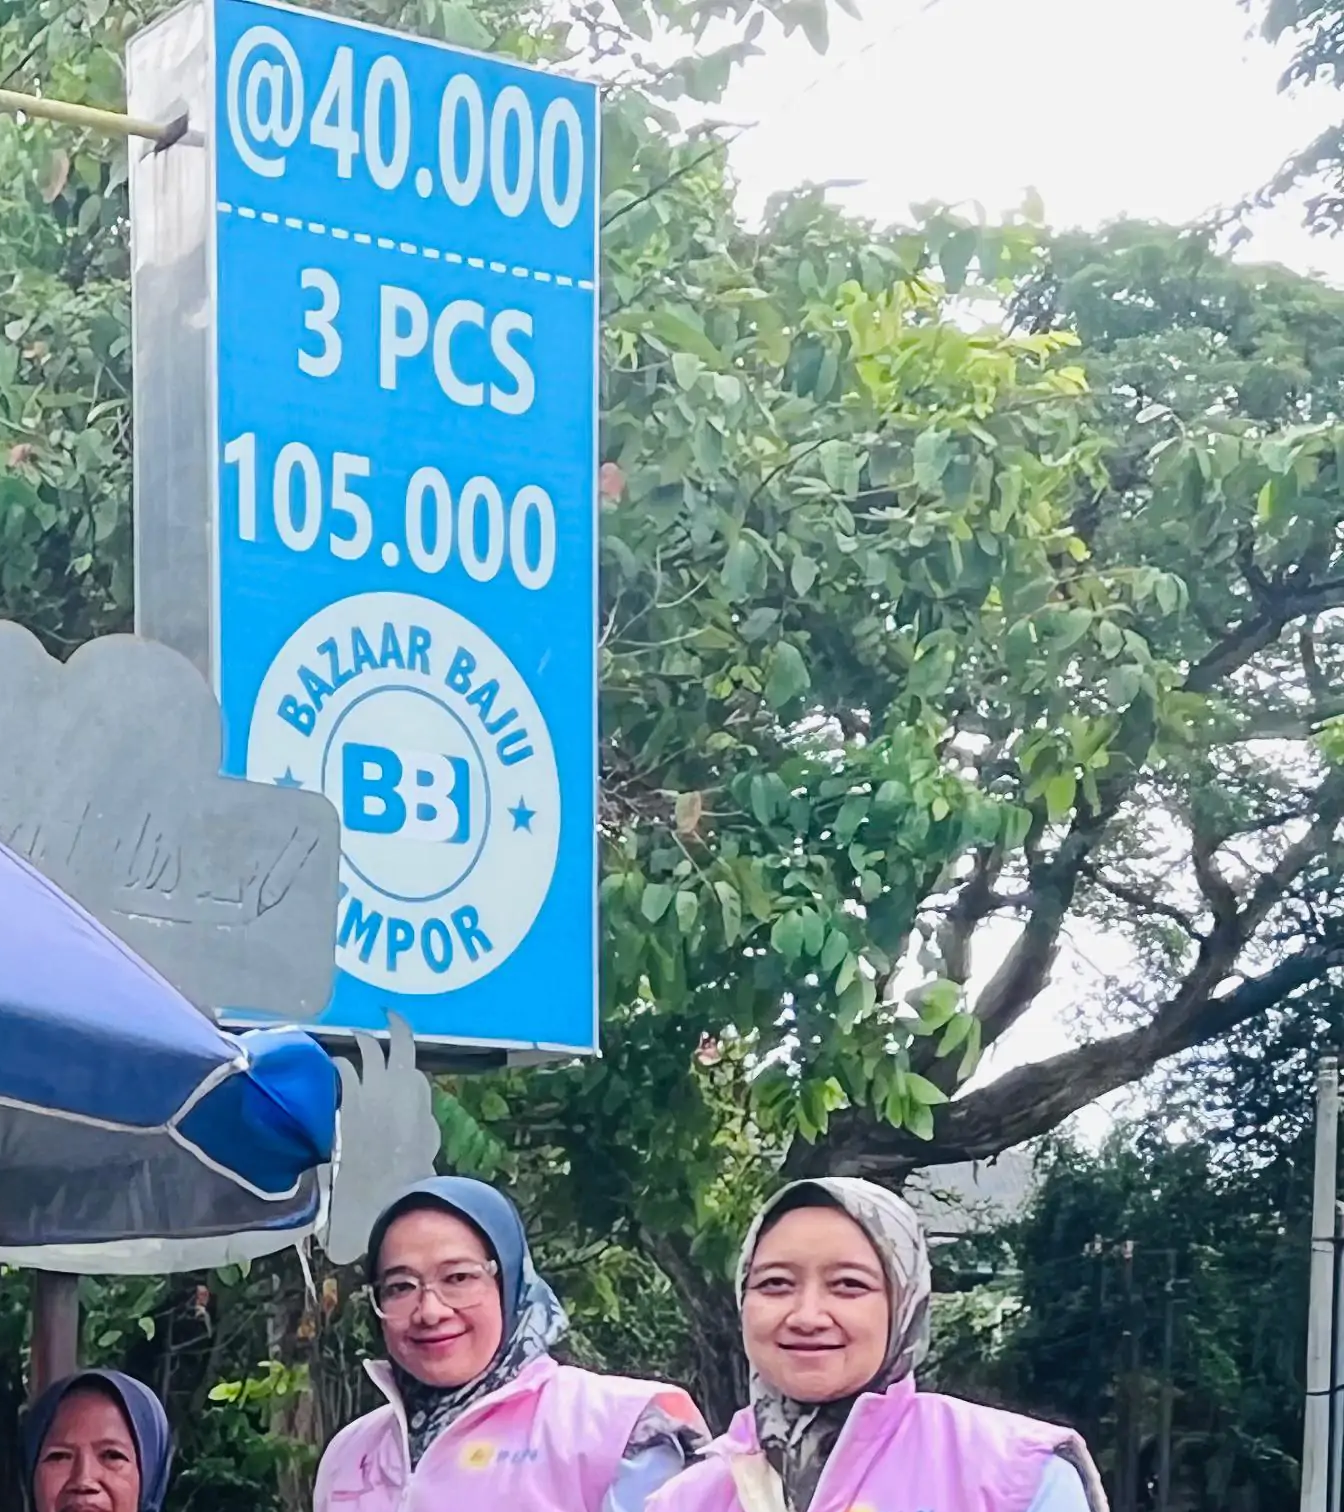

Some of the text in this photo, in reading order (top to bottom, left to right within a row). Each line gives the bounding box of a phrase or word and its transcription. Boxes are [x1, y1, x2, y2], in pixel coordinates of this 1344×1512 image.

[227, 26, 583, 228] @40.000
[297, 268, 535, 416] 3 PCS
[224, 432, 555, 590] 105.000
[277, 622, 534, 767] BAZAAR BAJU
[338, 882, 494, 973] MPOR
